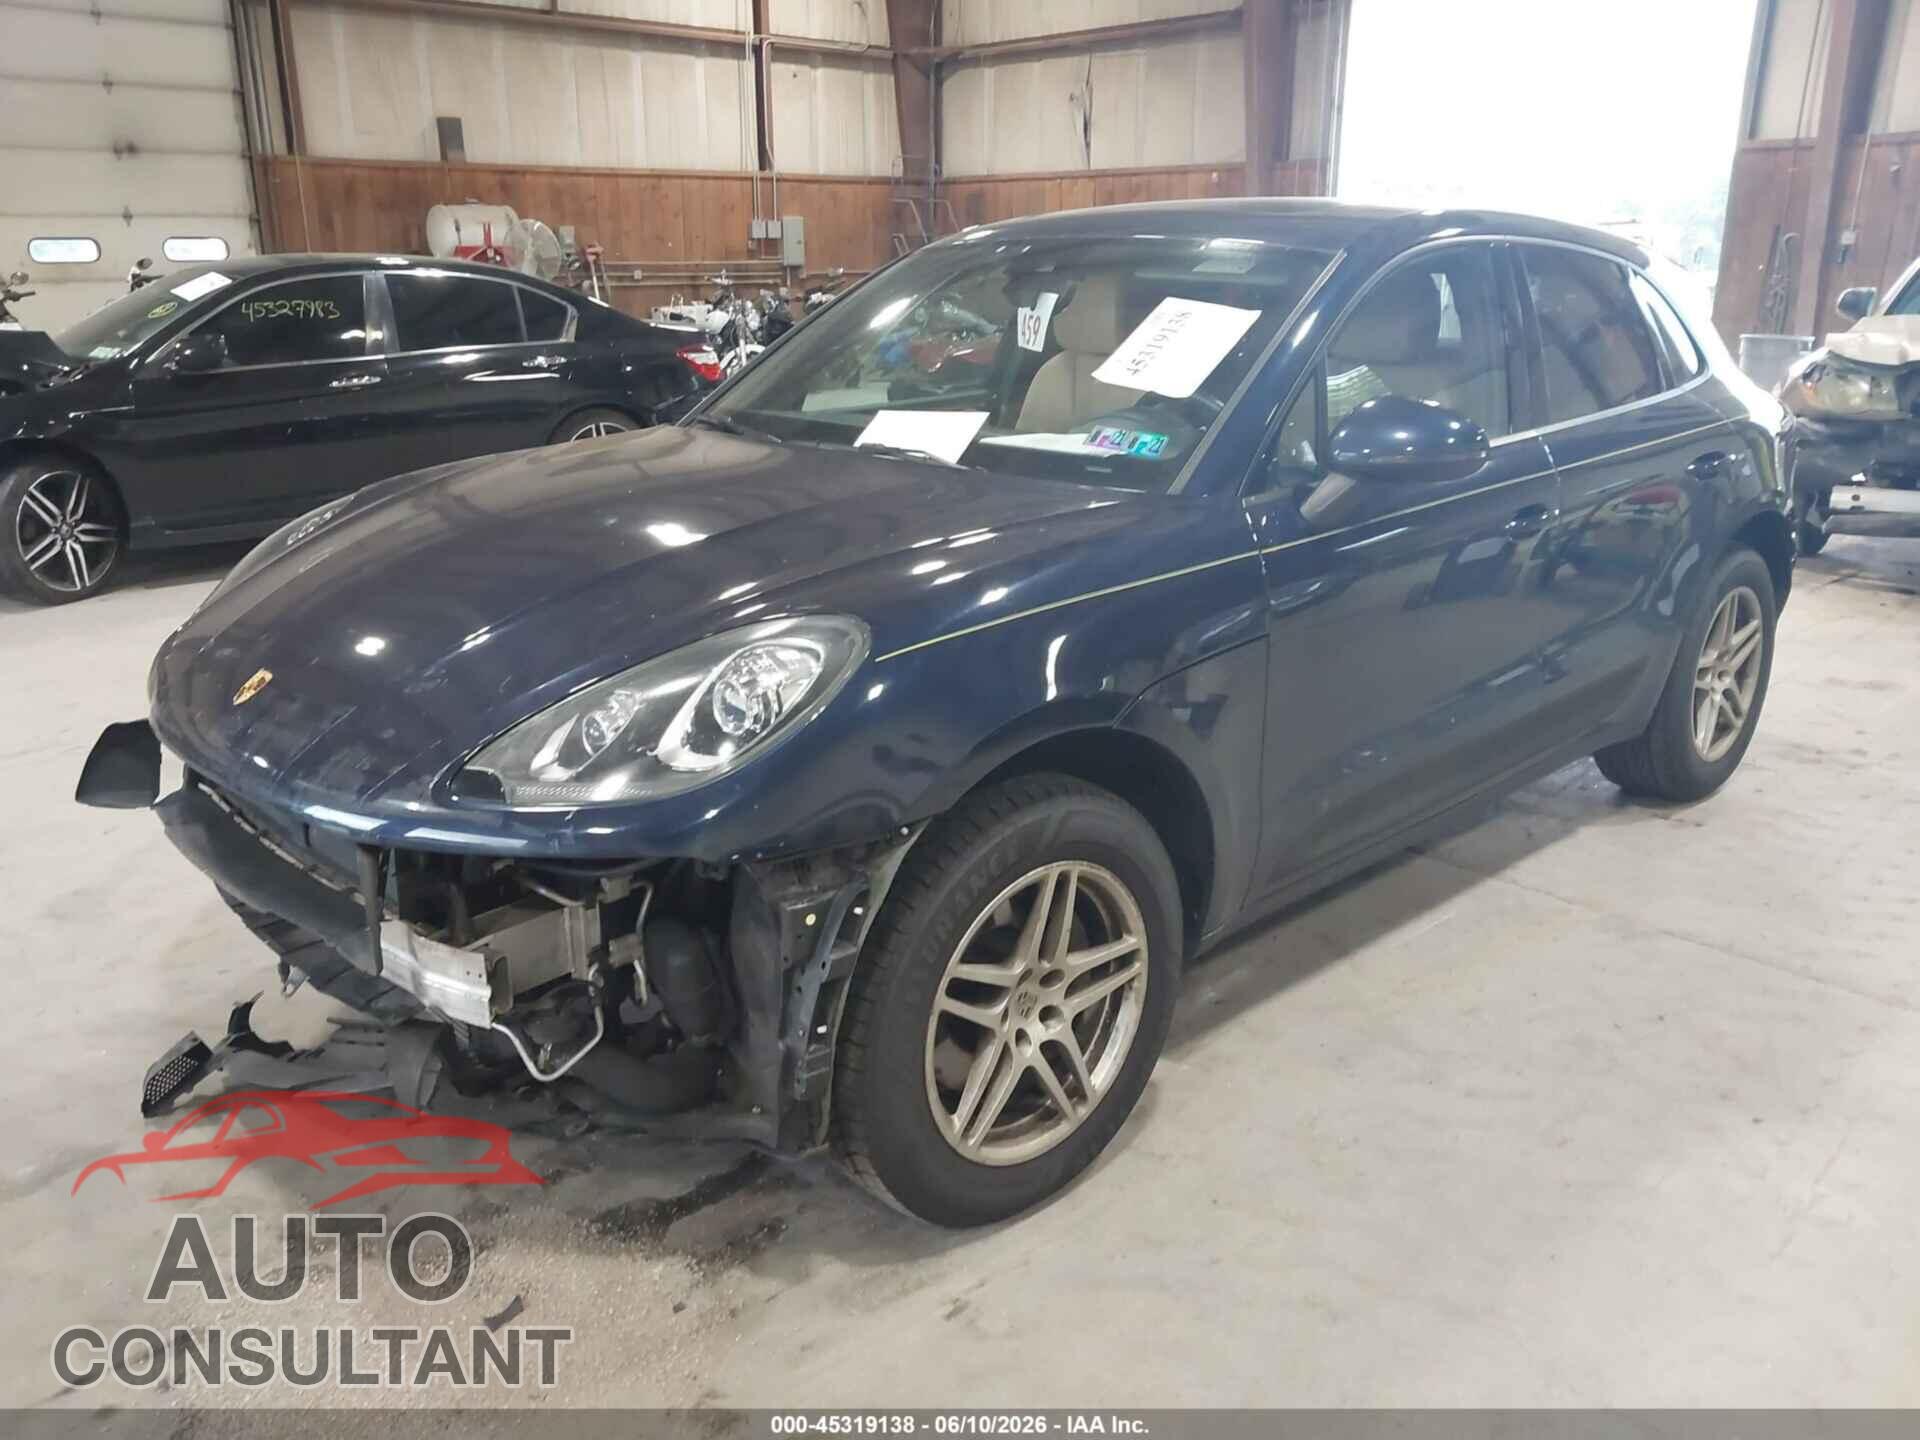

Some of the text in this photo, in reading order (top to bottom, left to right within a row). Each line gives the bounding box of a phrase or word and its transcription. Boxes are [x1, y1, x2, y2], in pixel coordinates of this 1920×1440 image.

[241, 300, 340, 322] 45327983
[1022, 312, 1041, 347] 459
[1126, 312, 1192, 376] 45319138
